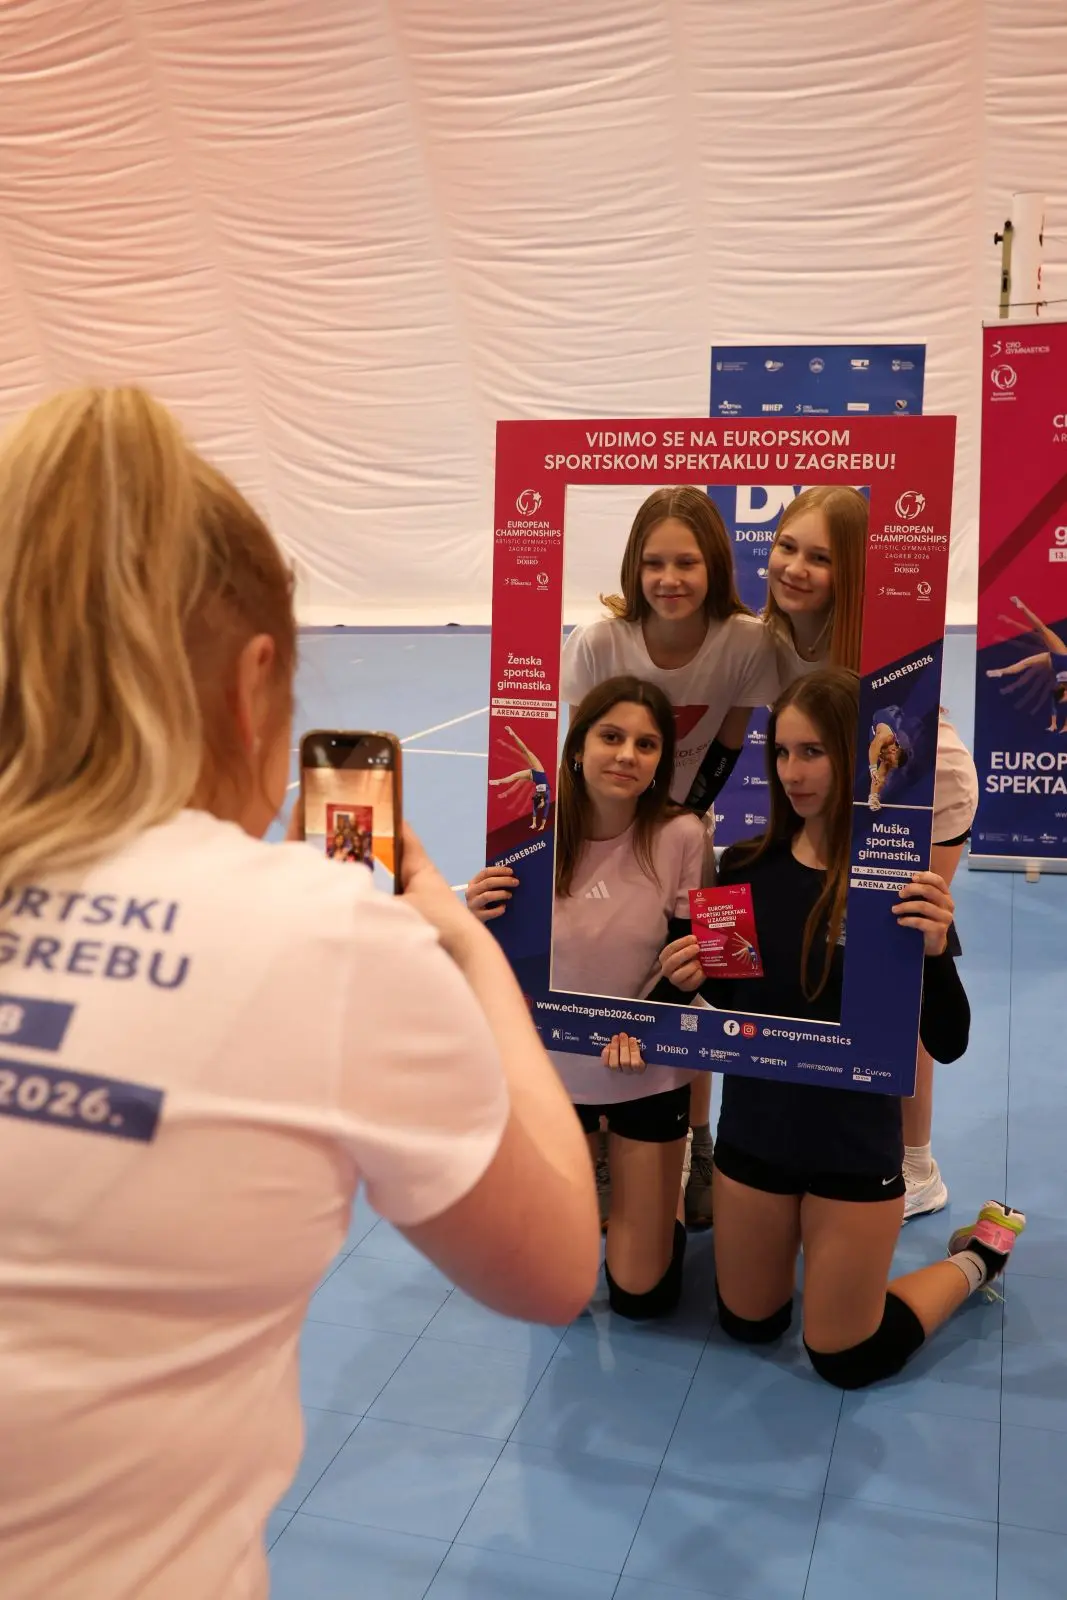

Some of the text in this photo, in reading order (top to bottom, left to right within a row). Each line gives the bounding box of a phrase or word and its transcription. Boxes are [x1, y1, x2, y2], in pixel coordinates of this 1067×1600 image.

[585, 430, 850, 448] VIDIMO SE NA EUROPSKOM
[544, 453, 896, 470] SPORTSKOM SPEKTAKLU U ZAGREBU!
[507, 520, 550, 529] EUROPEAN
[884, 525, 934, 534] EUROPEAN
[495, 529, 561, 537] CHAMPIONSHIPS
[870, 534, 947, 543] CHAMPIONSHIPS
[752, 548, 768, 556] FIG
[507, 652, 542, 666] Ženska
[503, 668, 546, 679] sportska
[871, 654, 934, 690] #ZAGREB2026
[497, 680, 552, 691] gimnastika
[990, 751, 1067, 771] EUROP
[985, 775, 1067, 795] SPEKTA
[872, 823, 910, 835] Muška
[865, 837, 915, 849] sportska
[495, 840, 546, 868] #ZAGREB2026
[858, 849, 921, 862] gimnastika
[876, 869, 908, 877] KOLOVOZA
[857, 880, 884, 889] ARENA
[707, 904, 734, 912] EUROPSKI
[721, 908, 747, 916] SPEKTAKL
[712, 915, 737, 923] ZAGREBU
[536, 1001, 656, 1023] www.echzagreb2026.com
[762, 1028, 852, 1046] @crogymnastics
[656, 1043, 689, 1055] DOBRO
[760, 1057, 787, 1067] SPIETH
